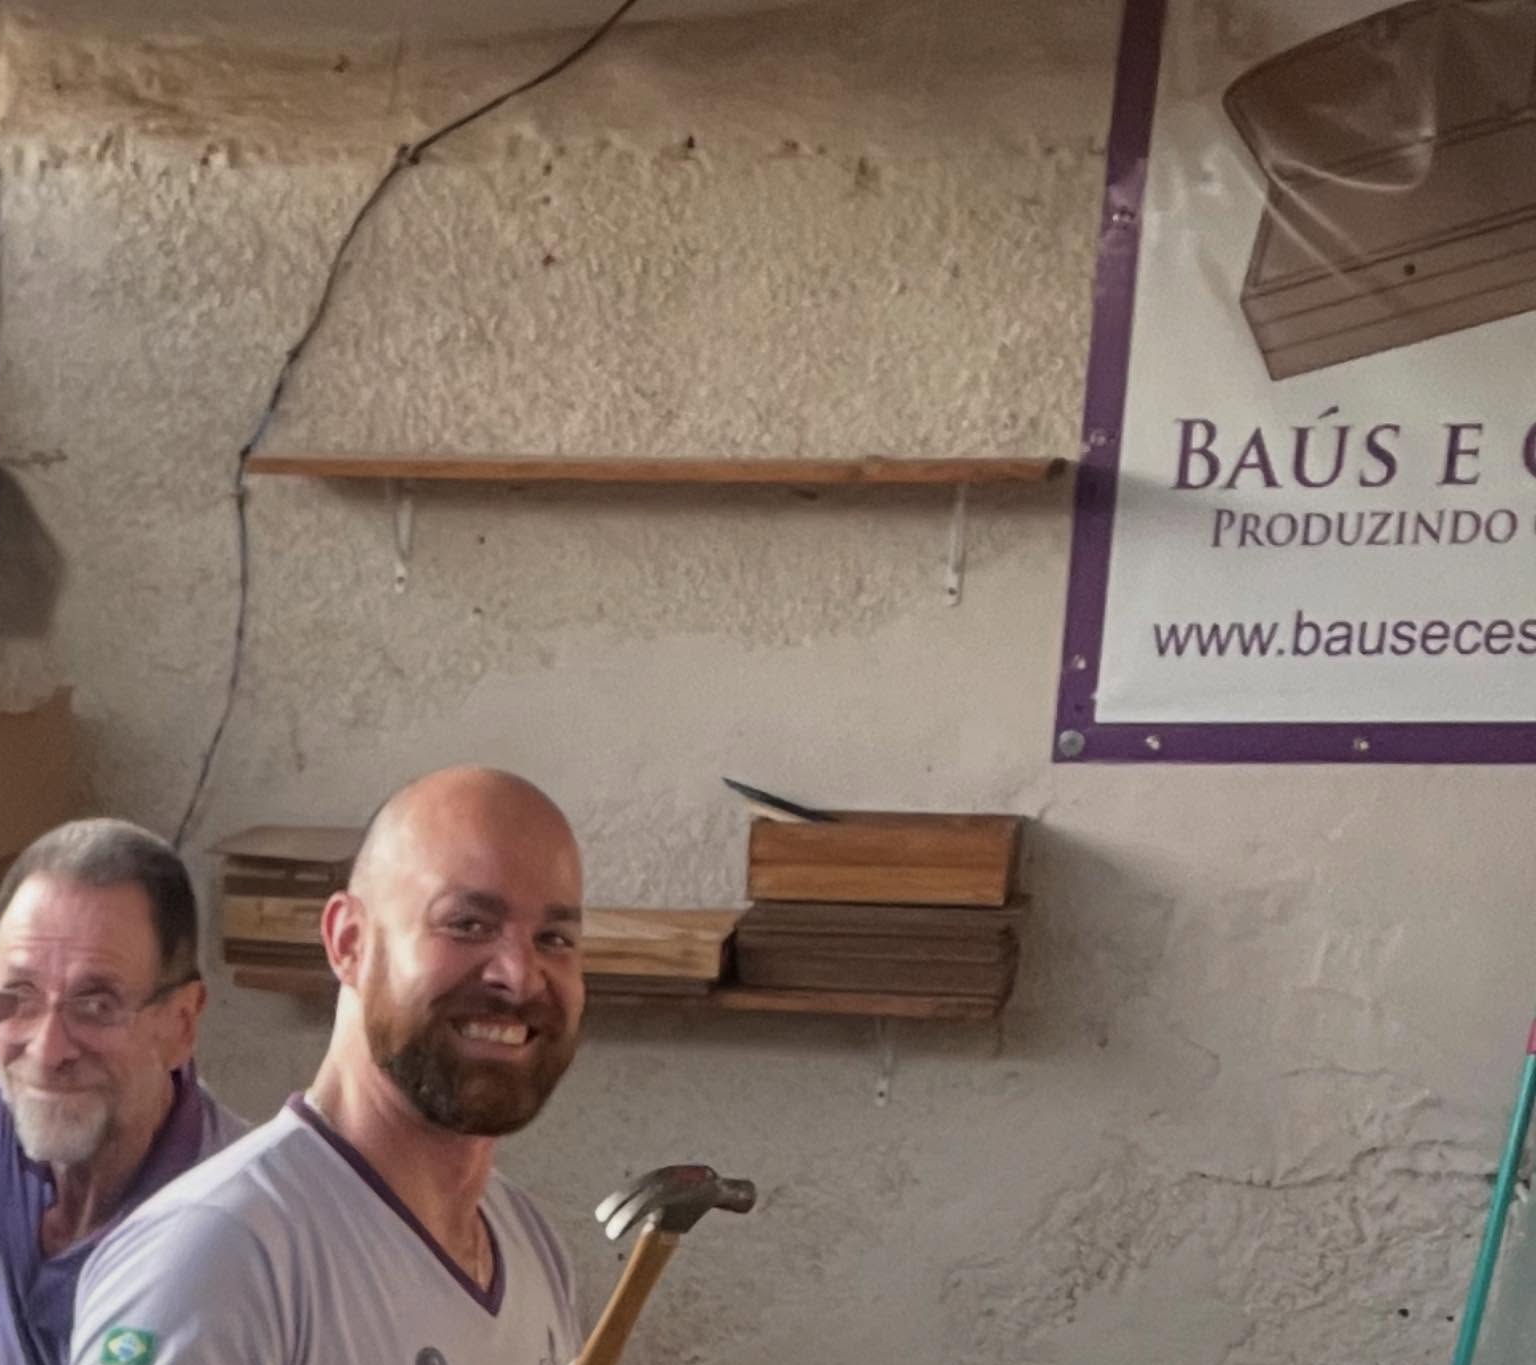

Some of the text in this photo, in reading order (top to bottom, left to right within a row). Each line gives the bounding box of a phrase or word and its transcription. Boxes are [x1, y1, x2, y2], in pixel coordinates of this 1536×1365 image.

[1170, 405, 1401, 491] BAÚS
[1436, 422, 1484, 487] E
[1211, 507, 1519, 548] PRODUZINDO
